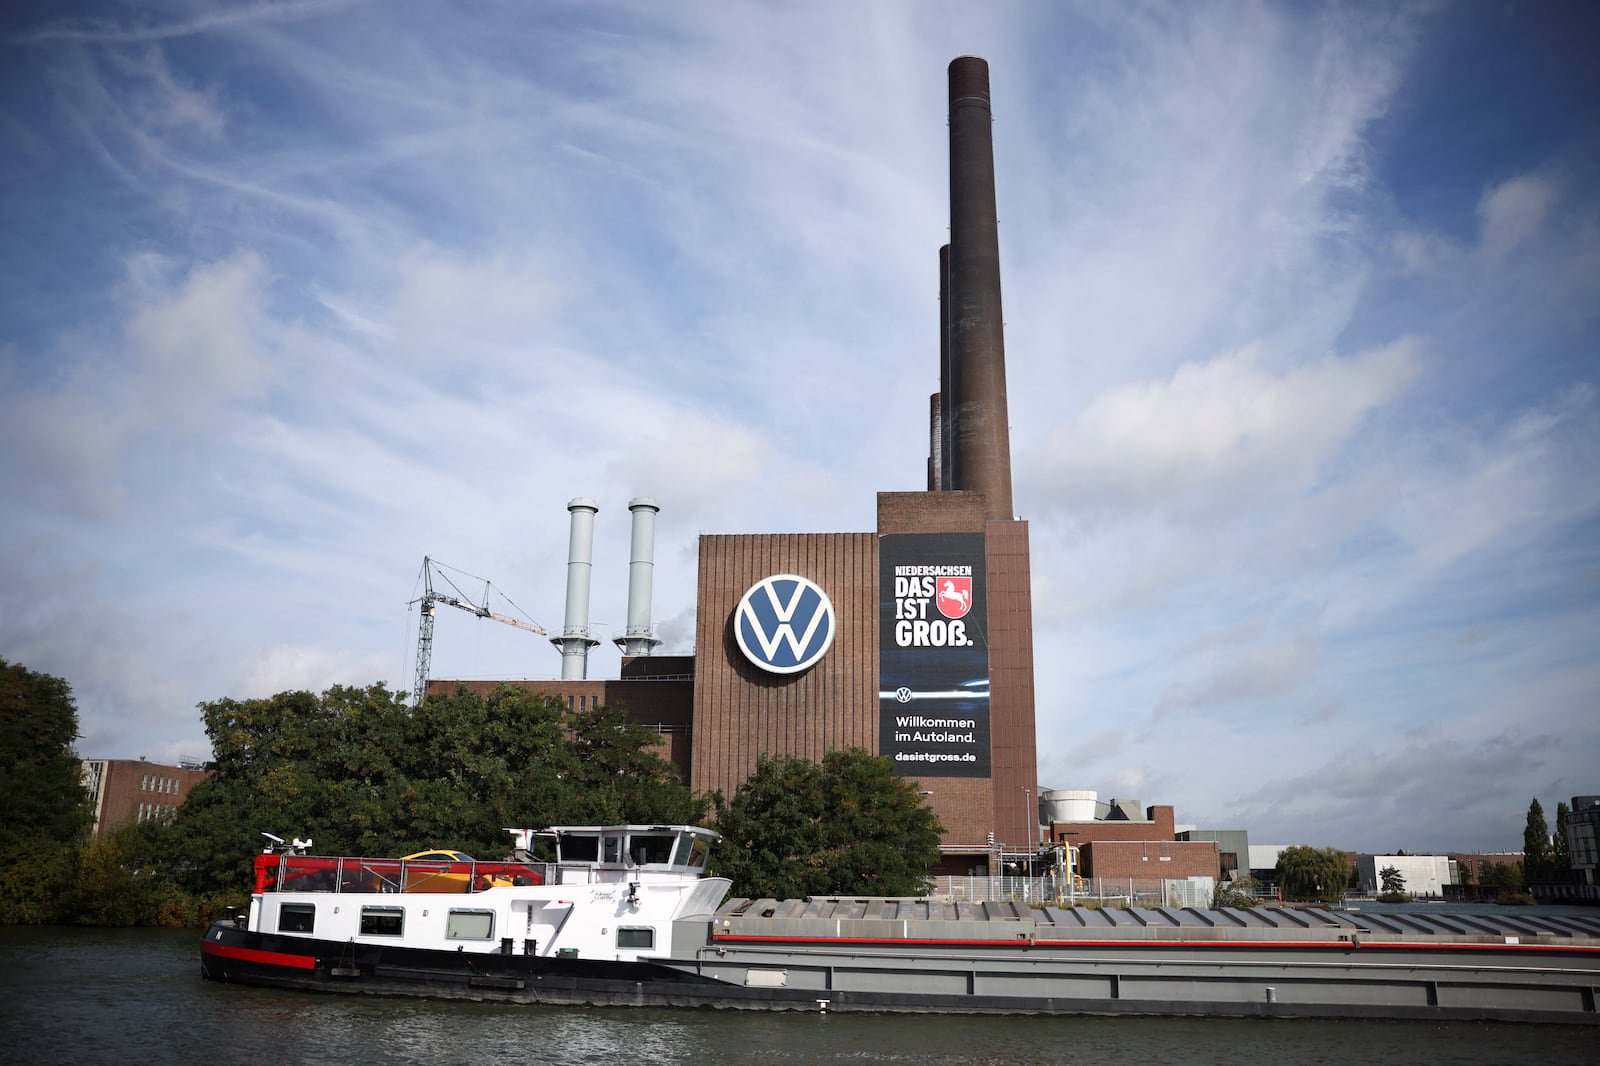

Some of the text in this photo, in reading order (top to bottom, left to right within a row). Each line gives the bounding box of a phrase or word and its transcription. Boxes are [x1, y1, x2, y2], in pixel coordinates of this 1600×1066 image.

[895, 565, 972, 576] NIEDERSACHSEN
[895, 576, 935, 598] DAS
[895, 598, 930, 620] IST
[738, 578, 832, 665] VW
[896, 687, 912, 702] VW
[896, 716, 975, 728] Willkommen
[895, 731, 976, 743] im Autoland.
[895, 752, 976, 763] dasistgross.de
